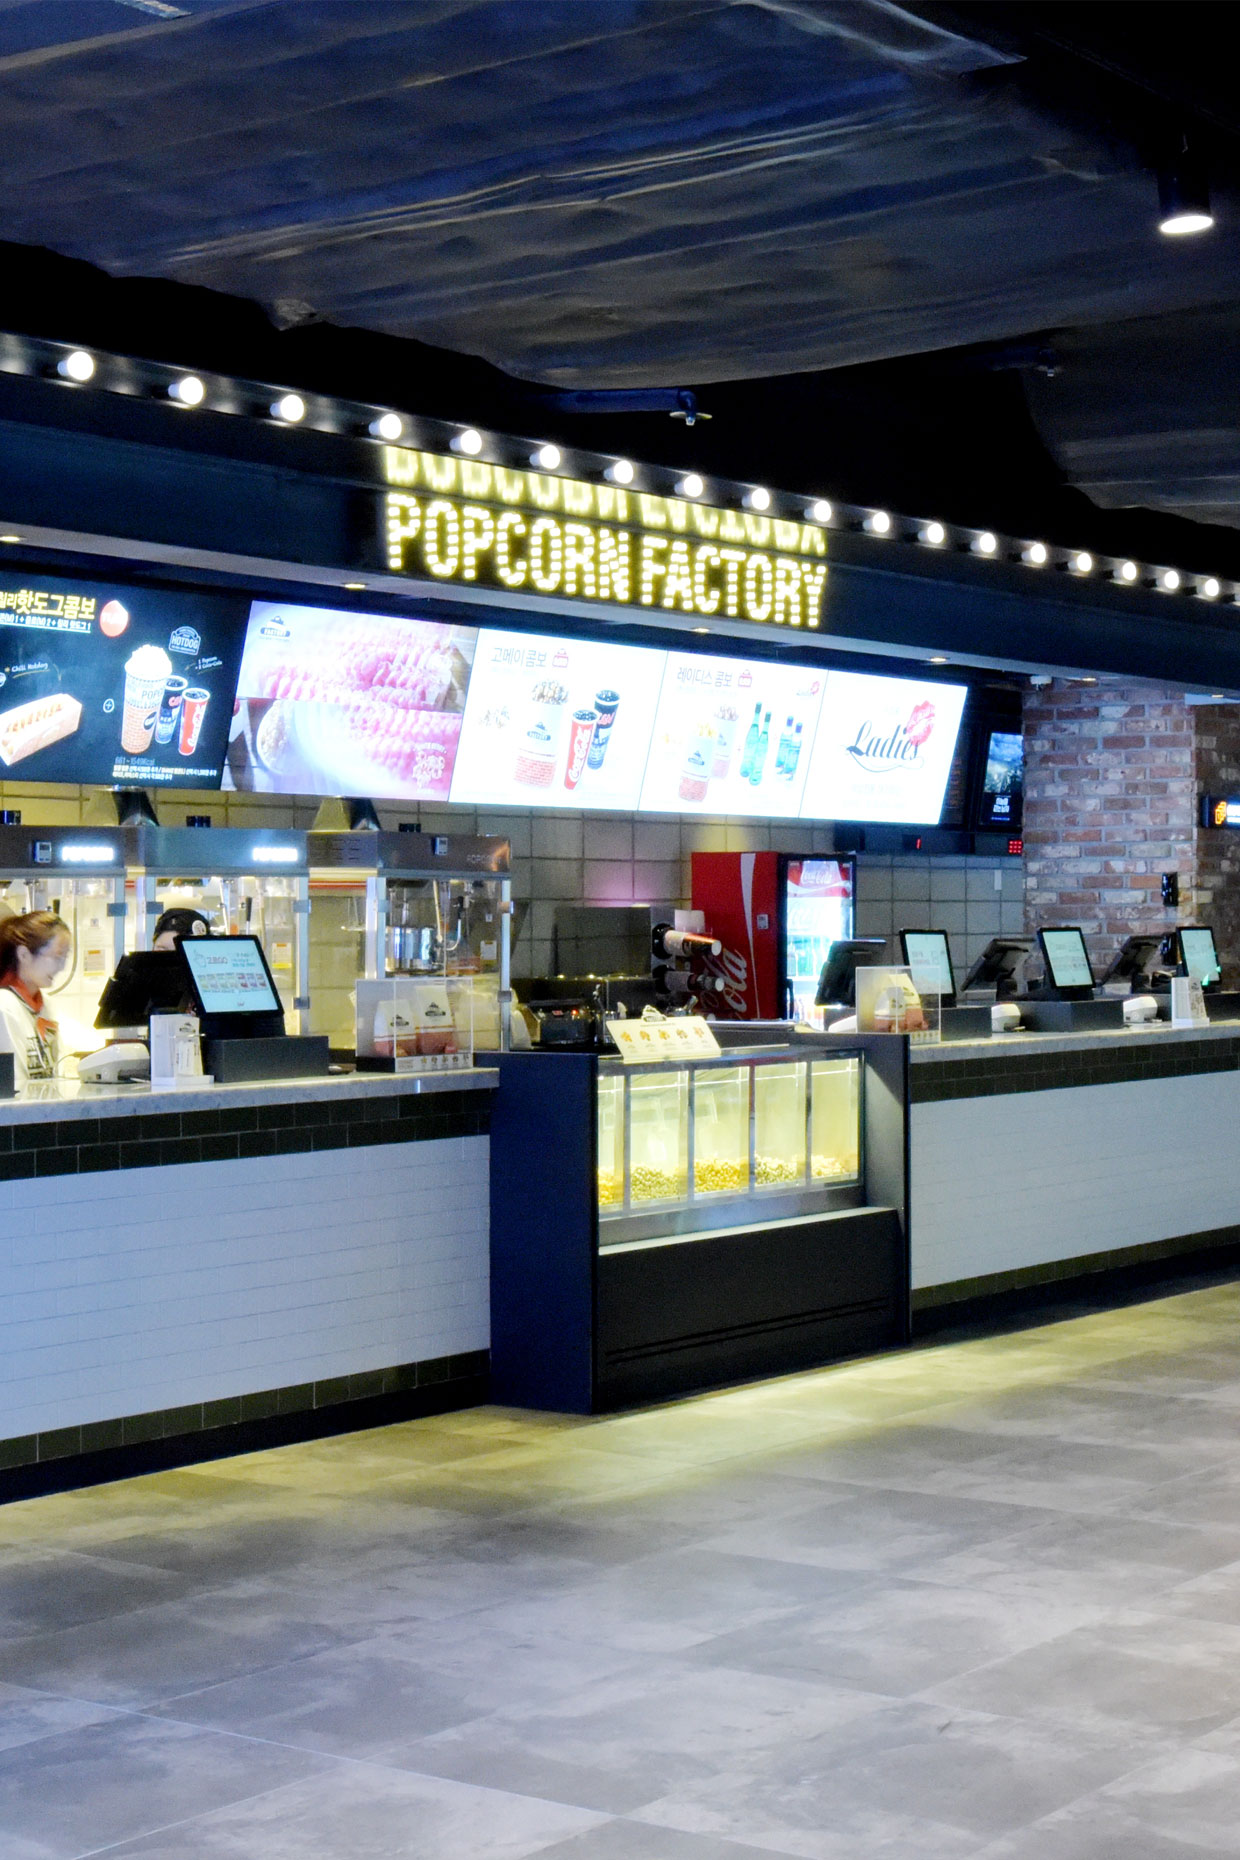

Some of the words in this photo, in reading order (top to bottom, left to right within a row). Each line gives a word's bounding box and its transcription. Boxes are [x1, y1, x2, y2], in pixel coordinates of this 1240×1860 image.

[386, 491, 630, 602] POPCORN
[641, 535, 827, 628] FACTORY
[171, 635, 199, 650] HOTDOG
[525, 649, 548, 668] 콤보
[846, 719, 922, 765] Ladies
